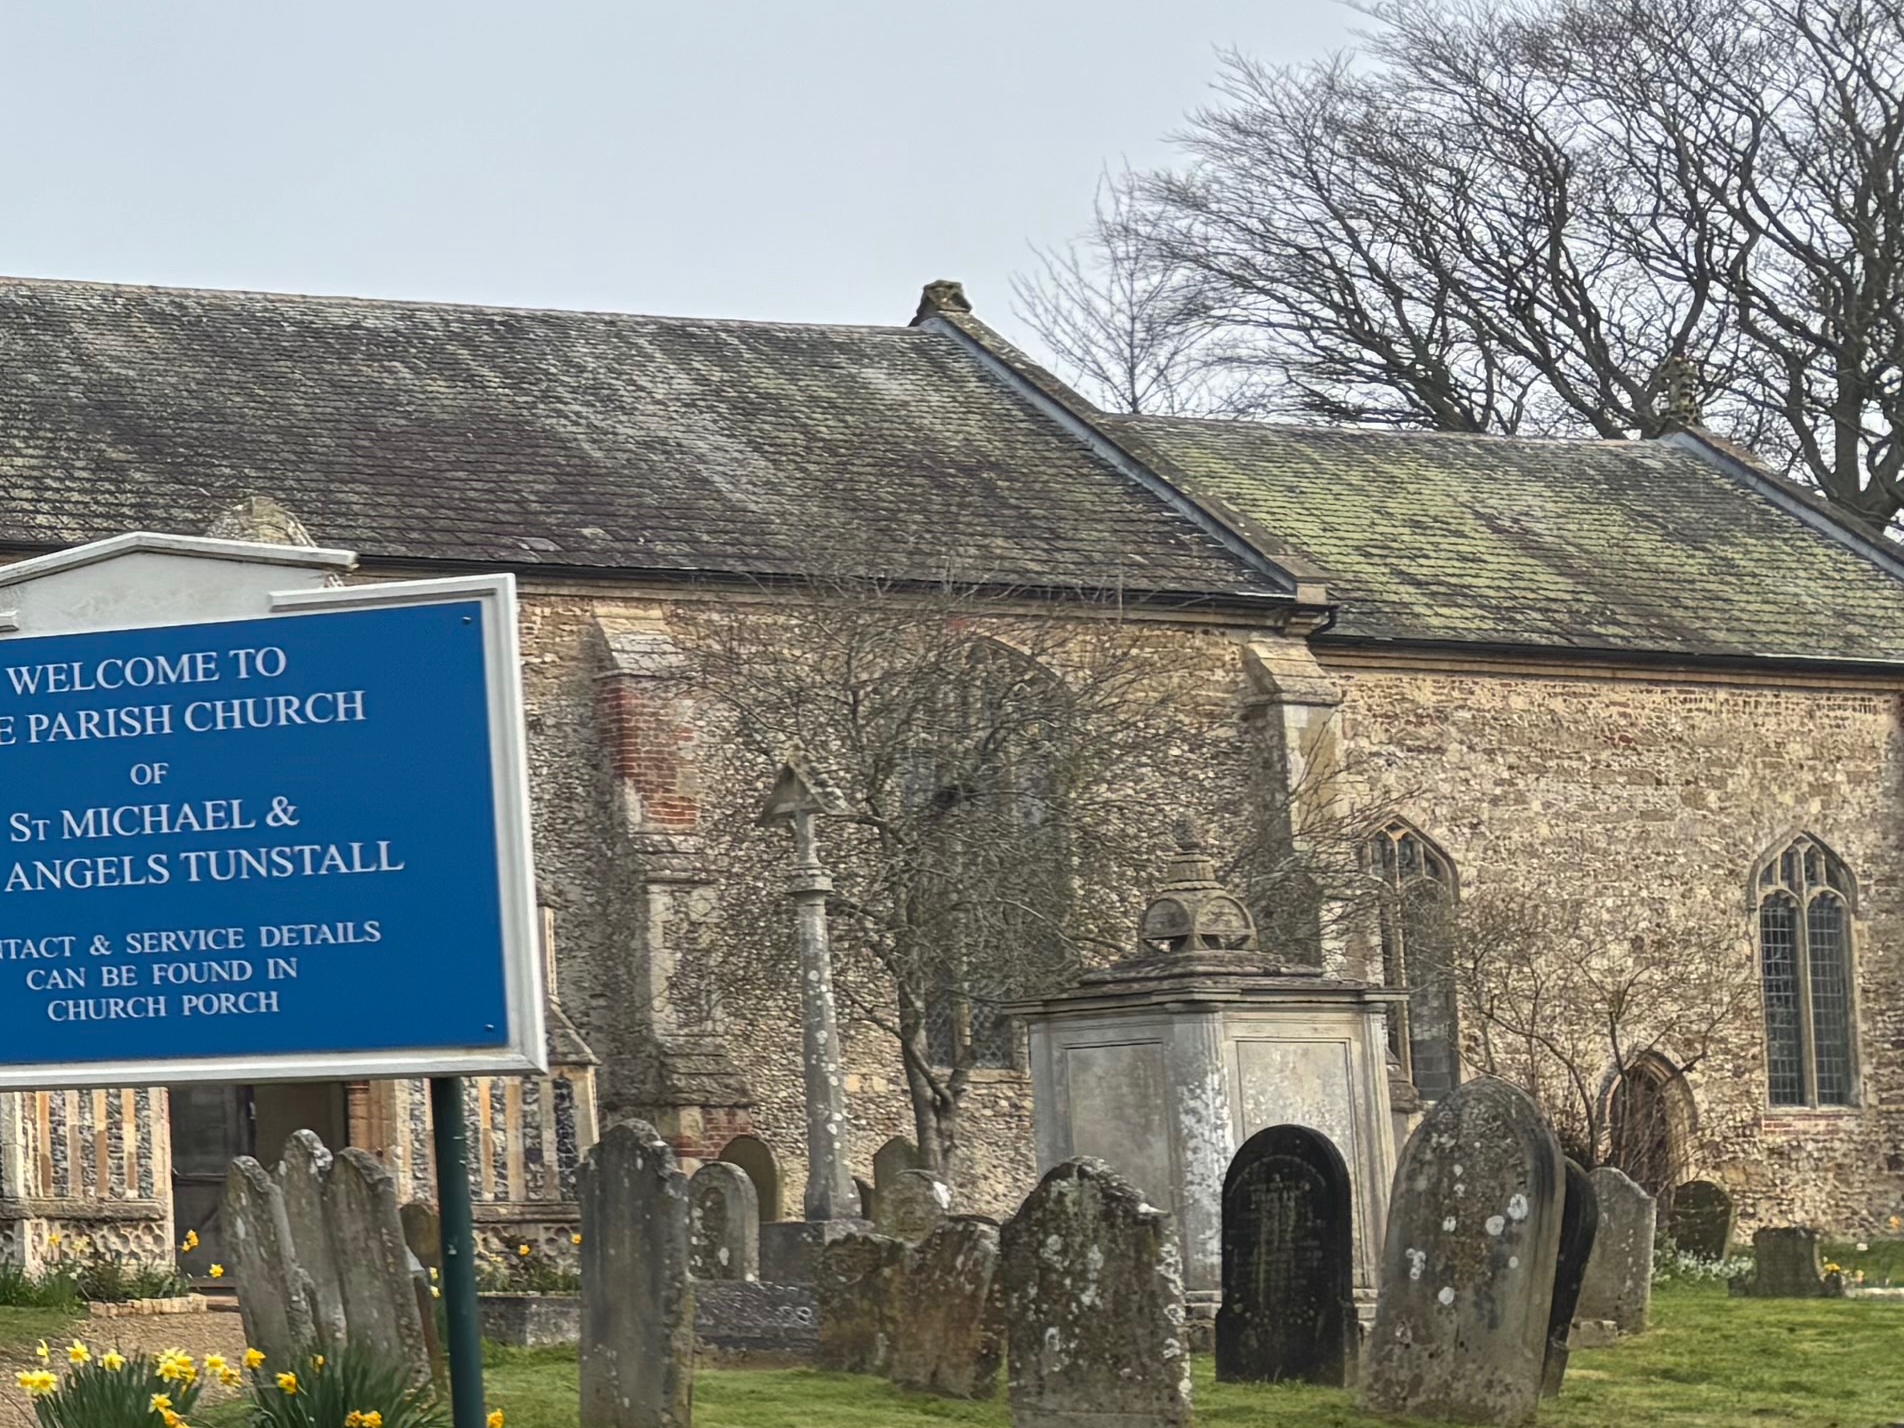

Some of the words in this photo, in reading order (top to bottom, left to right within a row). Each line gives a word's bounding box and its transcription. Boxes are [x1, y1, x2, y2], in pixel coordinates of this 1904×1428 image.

[5, 651, 220, 695] WELCOME
[229, 647, 287, 679] TO
[28, 704, 173, 743] PARISH
[184, 690, 366, 732] CHURCH
[130, 762, 169, 785] OF
[61, 799, 256, 839] MICHAEL
[265, 795, 300, 827] &
[4, 853, 170, 892] ANGELS
[179, 840, 405, 882] TUNSTALL
[89, 934, 112, 956] &
[126, 927, 244, 954] SERVICE
[259, 920, 381, 947] DETAILS
[26, 967, 85, 990] CAN
[101, 965, 138, 987] BE
[152, 960, 253, 985] FOUND
[267, 958, 297, 980] IN
[47, 995, 166, 1022] CHURCH
[182, 991, 279, 1016] PORCH
